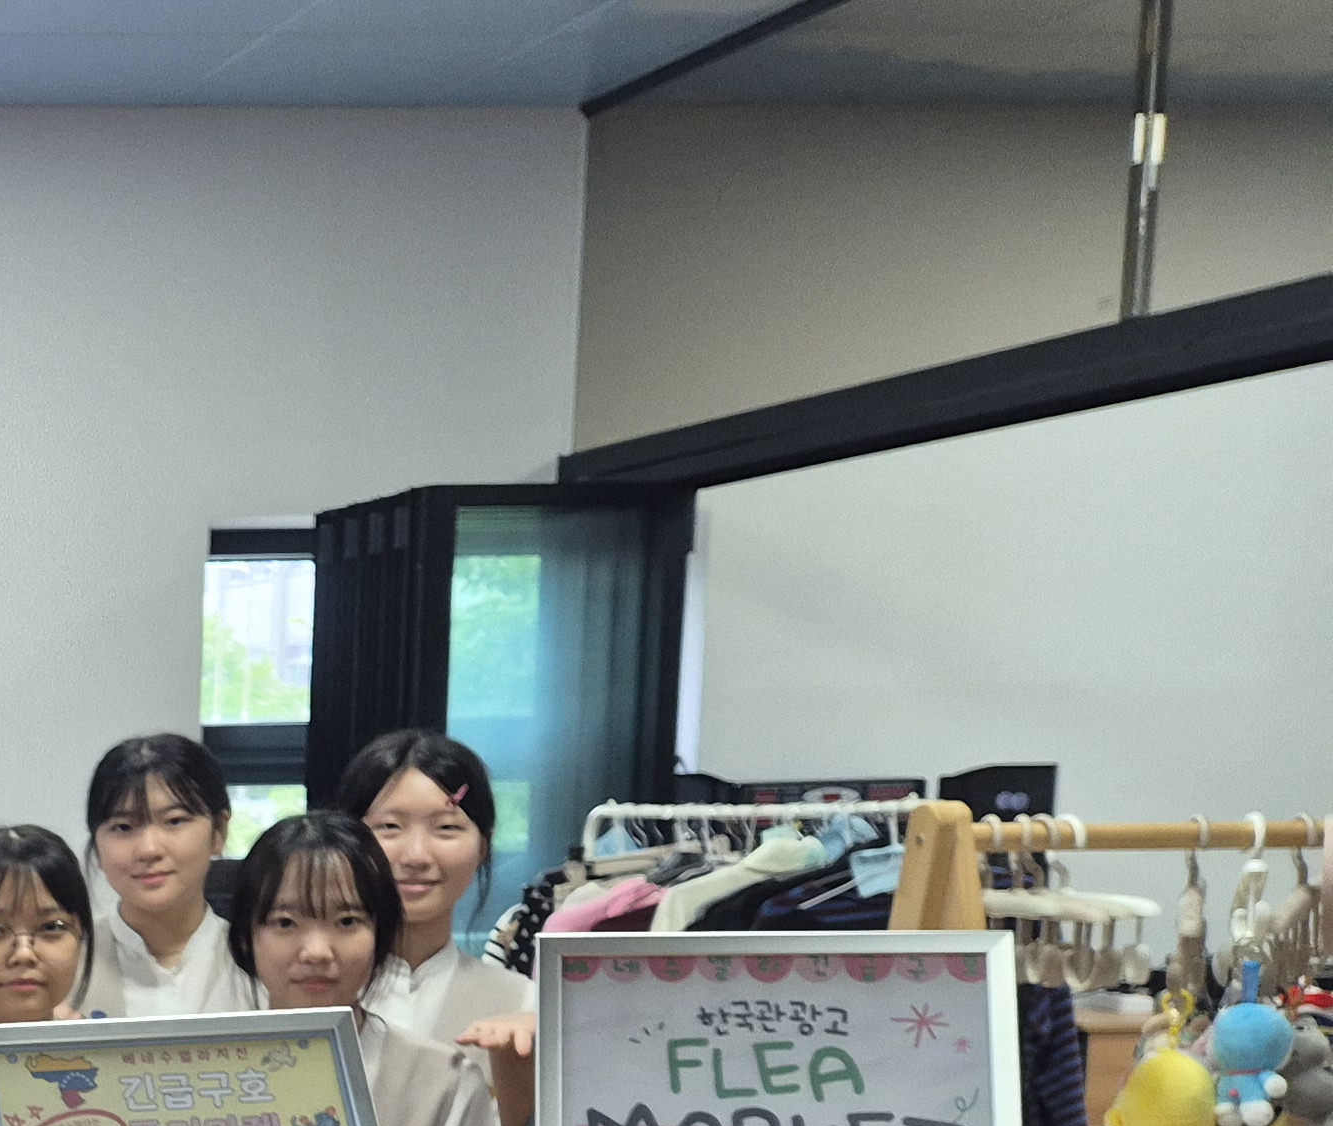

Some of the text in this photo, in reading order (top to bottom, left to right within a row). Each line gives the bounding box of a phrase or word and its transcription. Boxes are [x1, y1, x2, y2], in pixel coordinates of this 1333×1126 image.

[697, 1000, 849, 1037] 한국관광고
[119, 1069, 275, 1111] 긴급구호
[666, 1036, 866, 1102] FLEA
